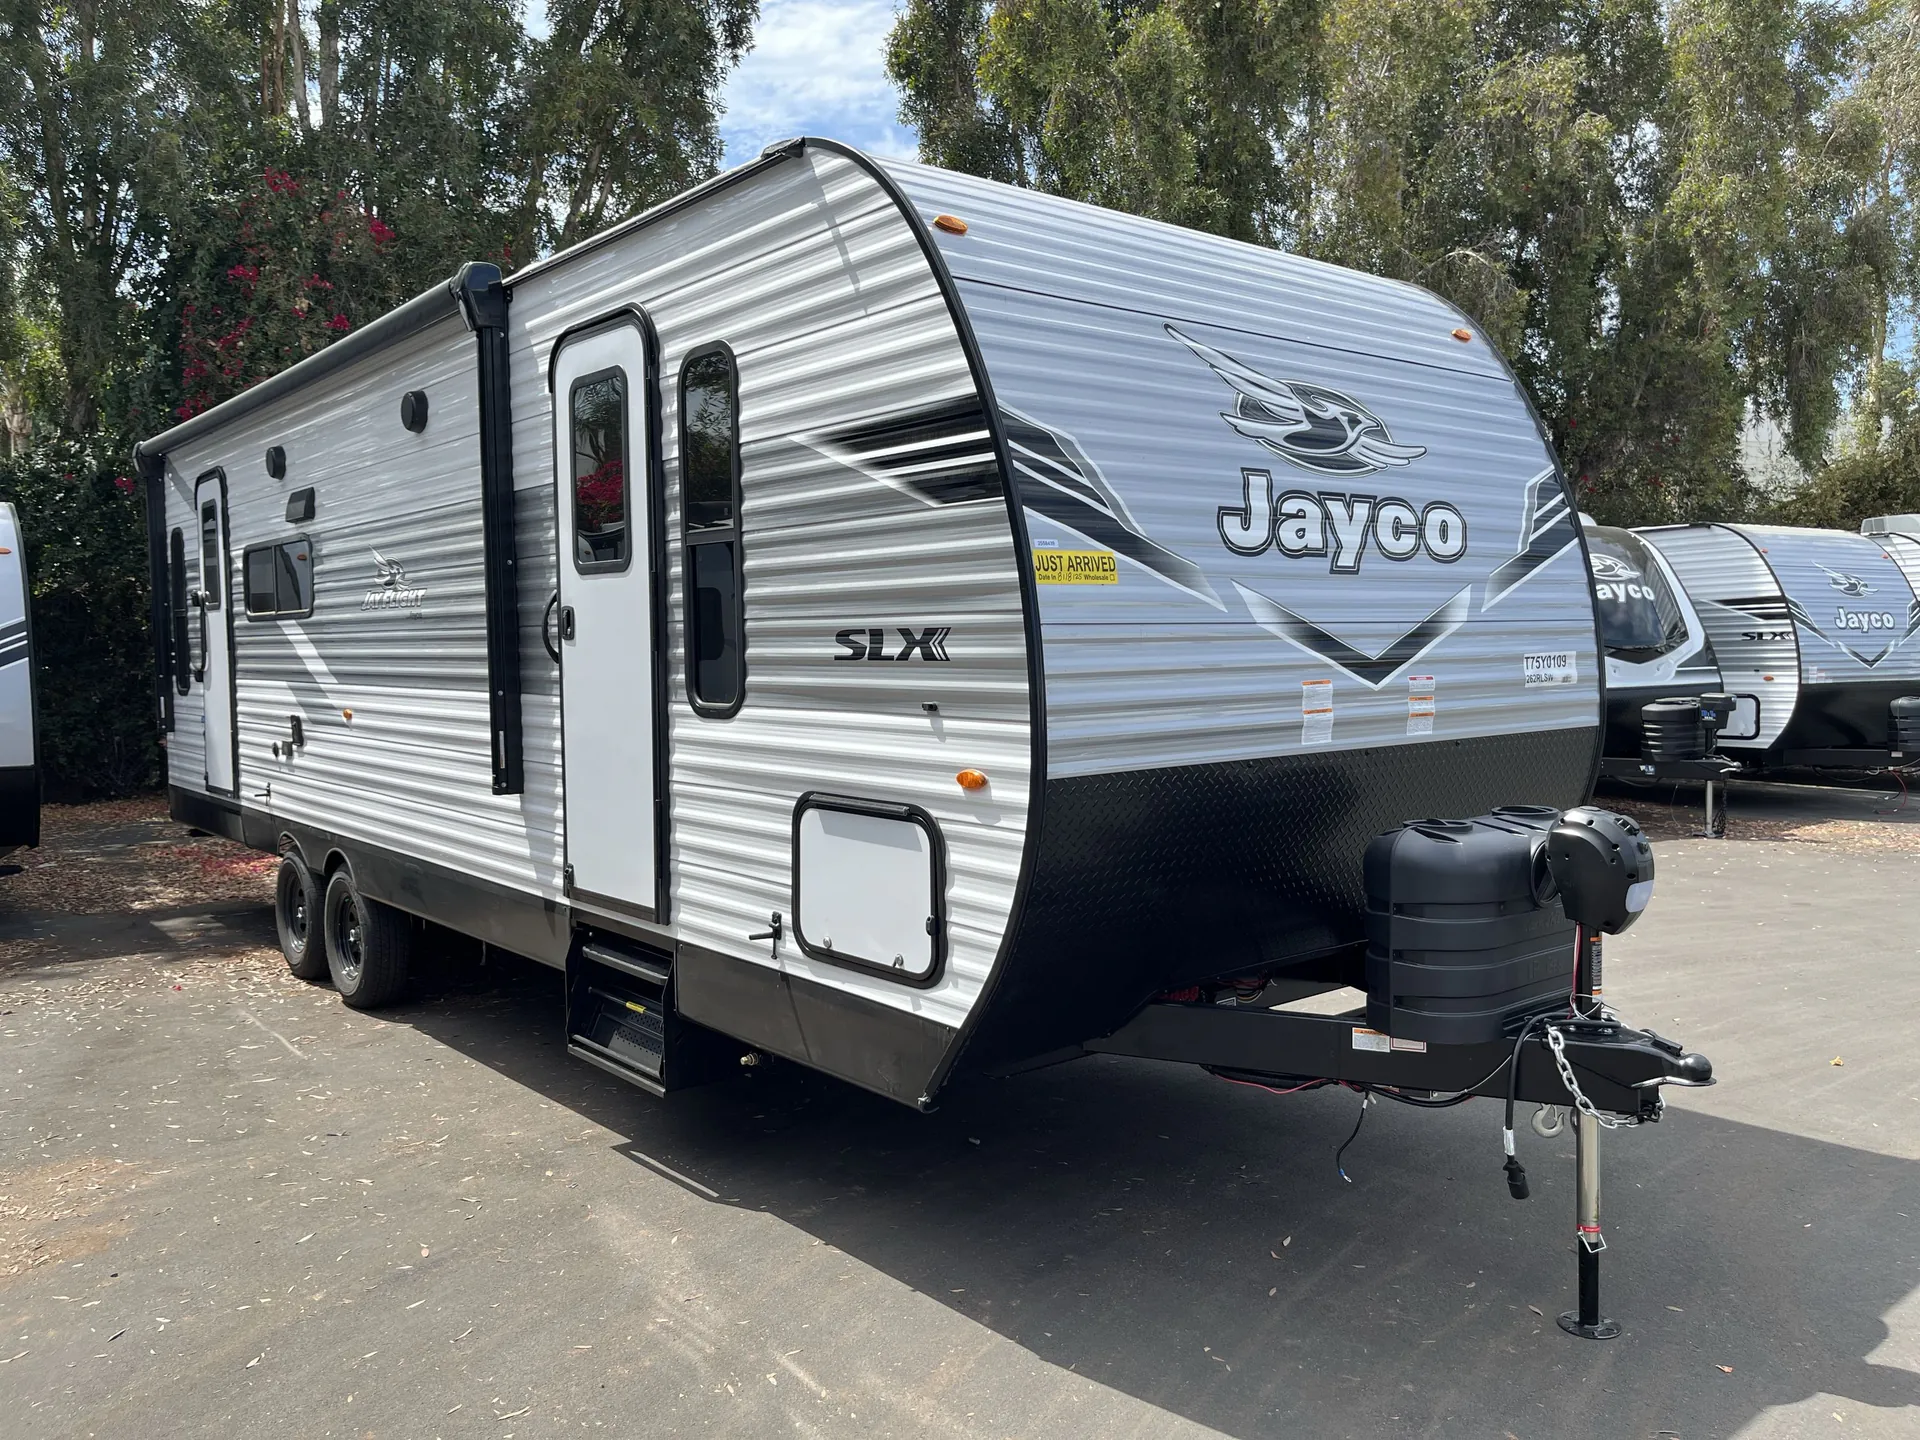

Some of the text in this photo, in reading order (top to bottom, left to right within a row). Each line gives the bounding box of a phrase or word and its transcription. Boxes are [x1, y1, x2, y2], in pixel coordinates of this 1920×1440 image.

[1217, 467, 1467, 575] Jayco
[1036, 555, 1116, 572] JUST ARRIVED
[361, 588, 427, 611] JAY FLIGHT
[1596, 582, 1655, 604] ayco
[1834, 606, 1895, 633] Jayco
[834, 627, 951, 661] SLX
[1741, 631, 1792, 641] SLX
[1524, 655, 1567, 670] T75Y0109
